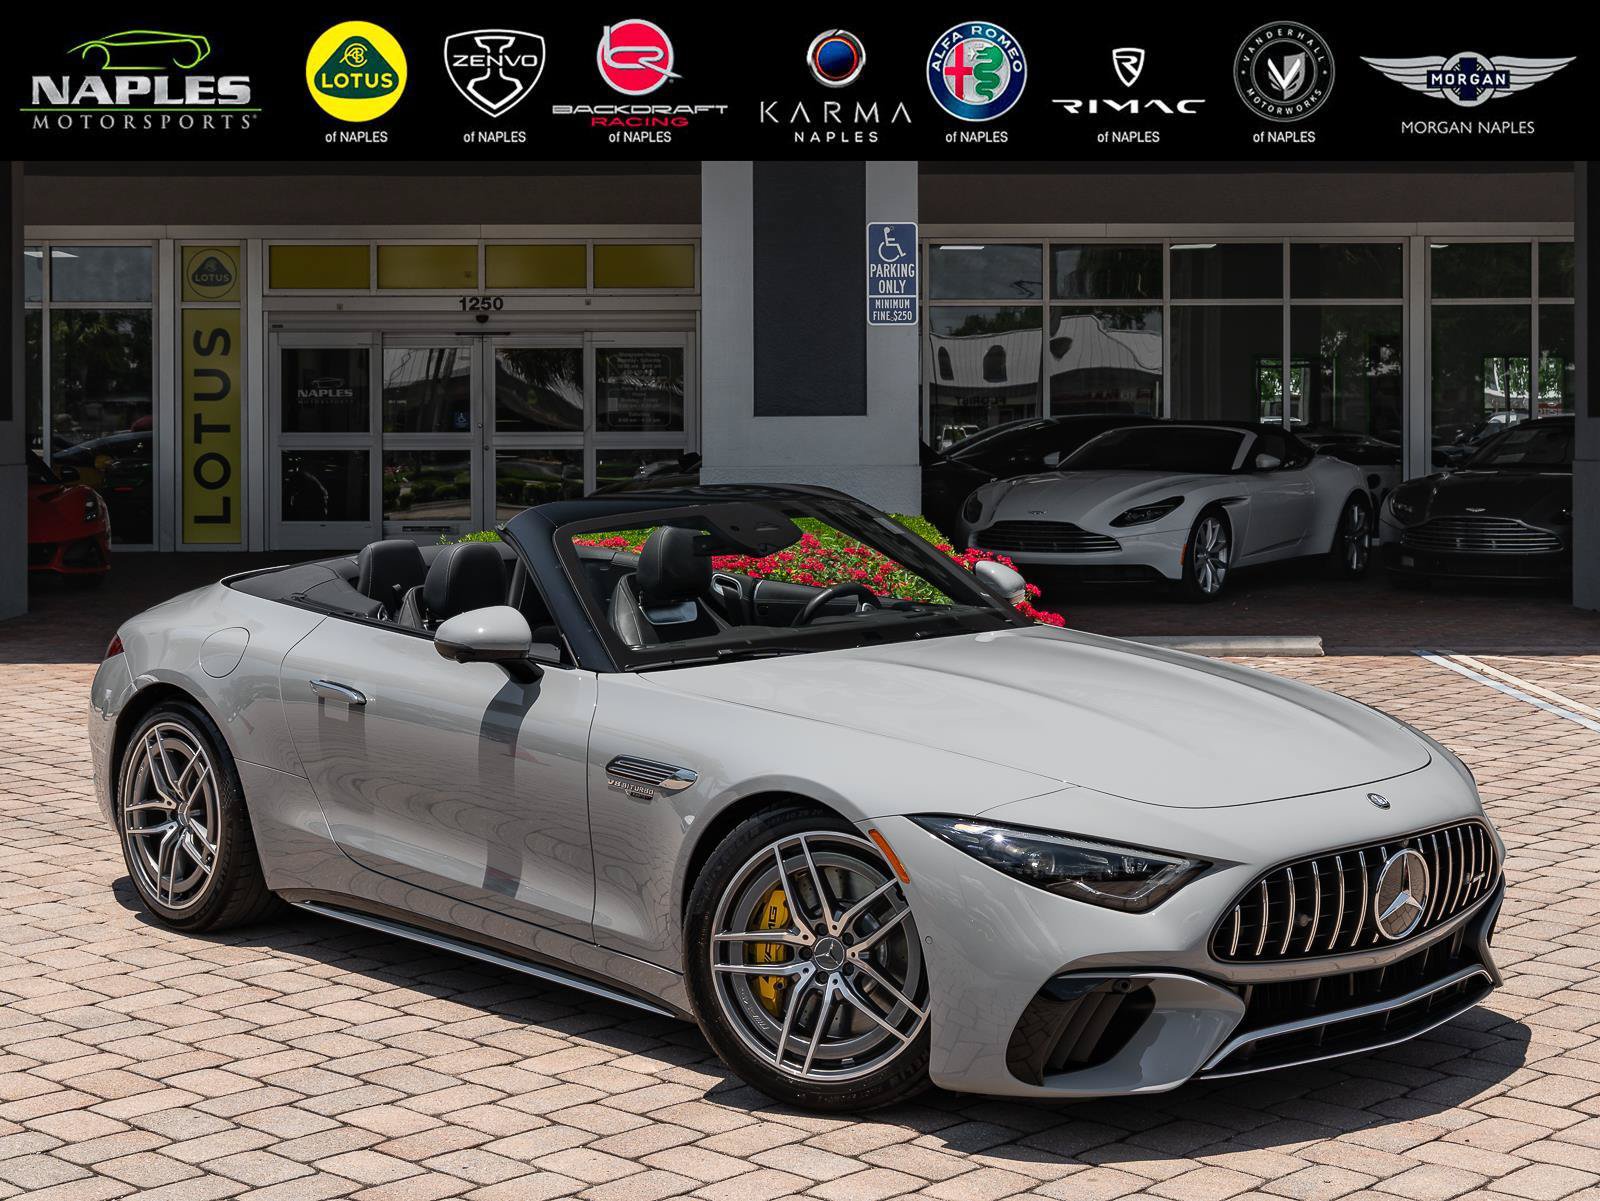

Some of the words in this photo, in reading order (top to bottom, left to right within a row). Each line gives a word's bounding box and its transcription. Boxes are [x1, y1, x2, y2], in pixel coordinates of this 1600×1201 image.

[870, 263, 915, 278] PARKING
[195, 273, 230, 283] LOTUS
[878, 280, 906, 294] ONLY
[459, 297, 504, 311] 1250
[875, 299, 910, 309] MINIMUM
[873, 311, 891, 321] FINE
[893, 310, 913, 322] $250
[297, 388, 354, 399] NAPLES
[193, 327, 232, 525] LOTUS
